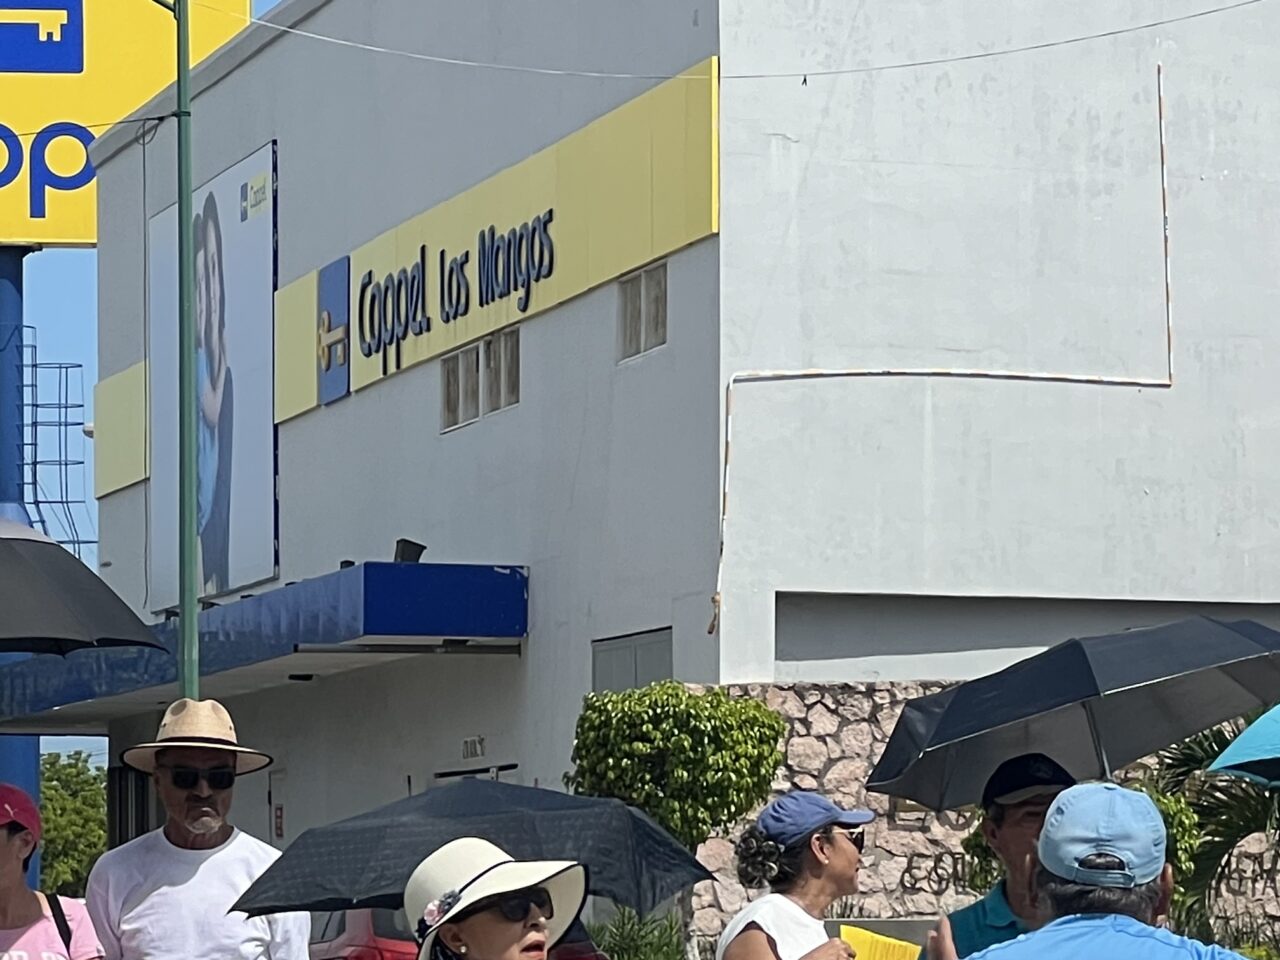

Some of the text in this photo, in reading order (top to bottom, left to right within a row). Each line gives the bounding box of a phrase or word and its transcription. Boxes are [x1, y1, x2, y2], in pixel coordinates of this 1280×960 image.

[358, 208, 554, 376] Coppel Los Mangos
